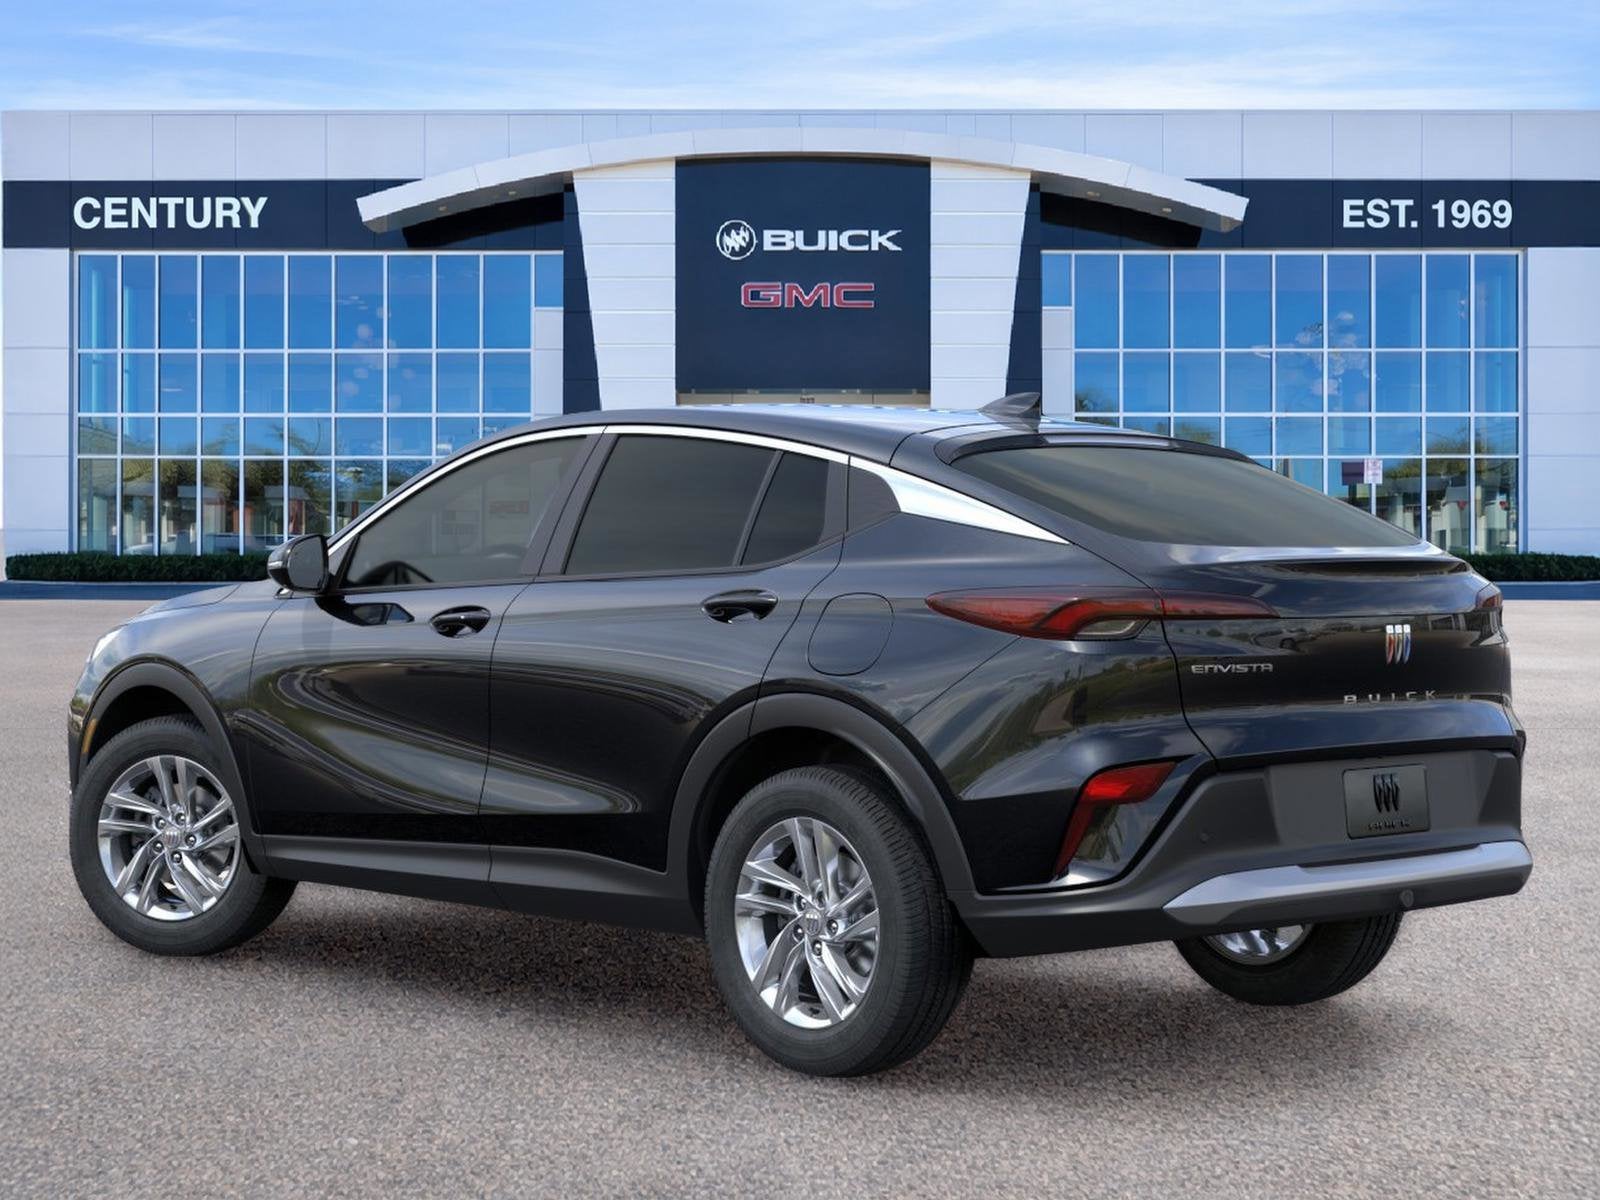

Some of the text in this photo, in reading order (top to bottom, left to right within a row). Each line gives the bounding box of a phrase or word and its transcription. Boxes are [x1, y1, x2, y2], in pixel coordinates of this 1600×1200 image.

[73, 196, 268, 230] CENTURY
[1342, 198, 1513, 229] EST. 1969
[762, 229, 903, 252] BUICK
[740, 281, 876, 309] GMC
[1343, 689, 1436, 705] BUICK
